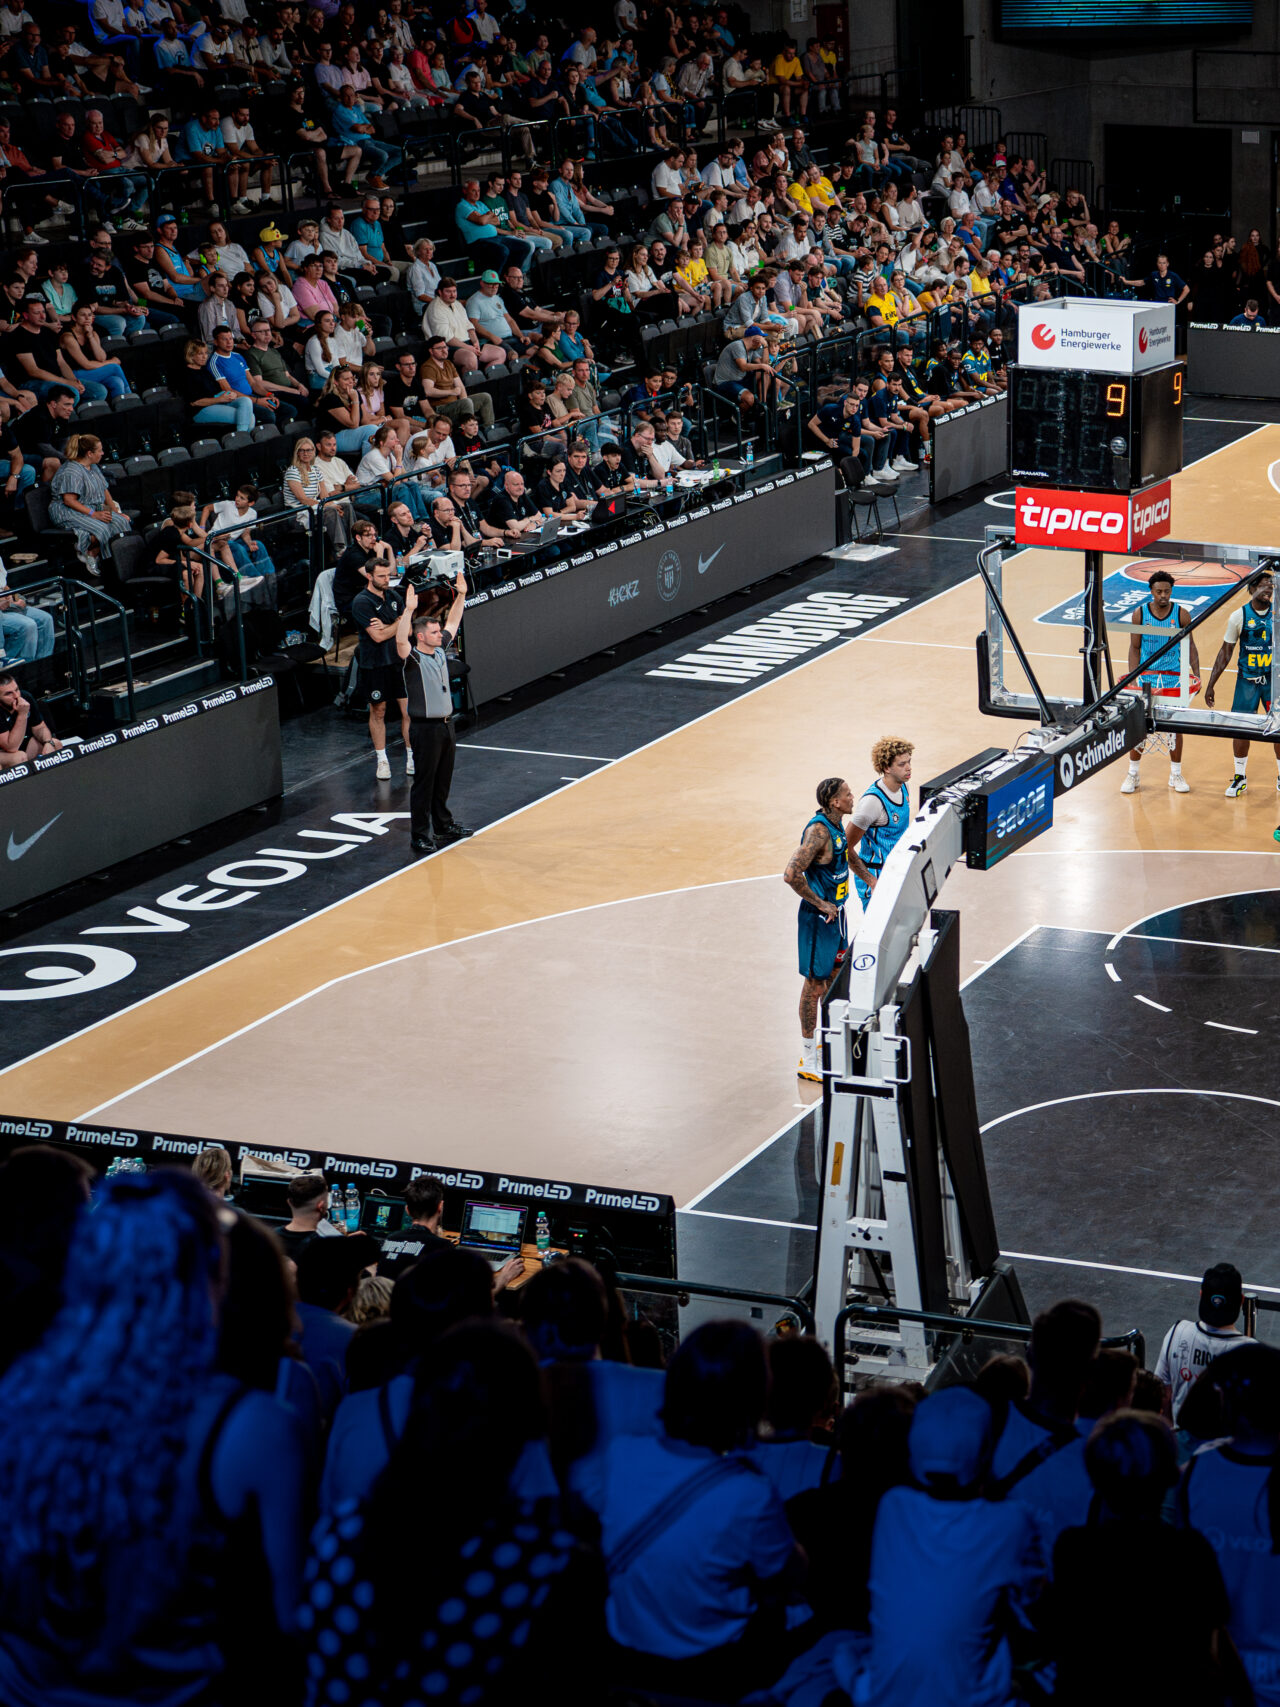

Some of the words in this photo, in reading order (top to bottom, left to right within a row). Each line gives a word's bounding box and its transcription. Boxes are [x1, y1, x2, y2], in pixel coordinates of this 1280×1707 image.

[1060, 328, 1111, 340] Hamburger
[1060, 338, 1122, 351] Energiewerke
[1189, 322, 1218, 331] PrimeLED
[1223, 324, 1251, 332] PrimeLED
[1106, 383, 1126, 416] 9
[1173, 372, 1182, 404] 9
[1020, 497, 1124, 535] tipico
[1133, 498, 1170, 536] tipico
[1103, 590, 1151, 613] Credit
[644, 591, 910, 684] HAMBURG
[1248, 653, 1273, 668] EW
[0, 765, 29, 785] meLED
[33, 748, 74, 771] PrimeLED
[79, 733, 117, 755] PrimeLED
[122, 718, 159, 740] PrimeLED
[162, 703, 198, 724] PrimeLED
[202, 689, 237, 710] PrimeLED
[239, 676, 274, 697] PrimeLED
[1075, 728, 1126, 777] Schindler
[78, 811, 412, 935] VEOLIA
[0, 1122, 53, 1138] meLED
[65, 1126, 138, 1148] PrimeLED
[324, 1156, 398, 1179] PrimeLED
[497, 1177, 572, 1200] PrimeLED
[585, 1189, 660, 1212] PrimeLED
